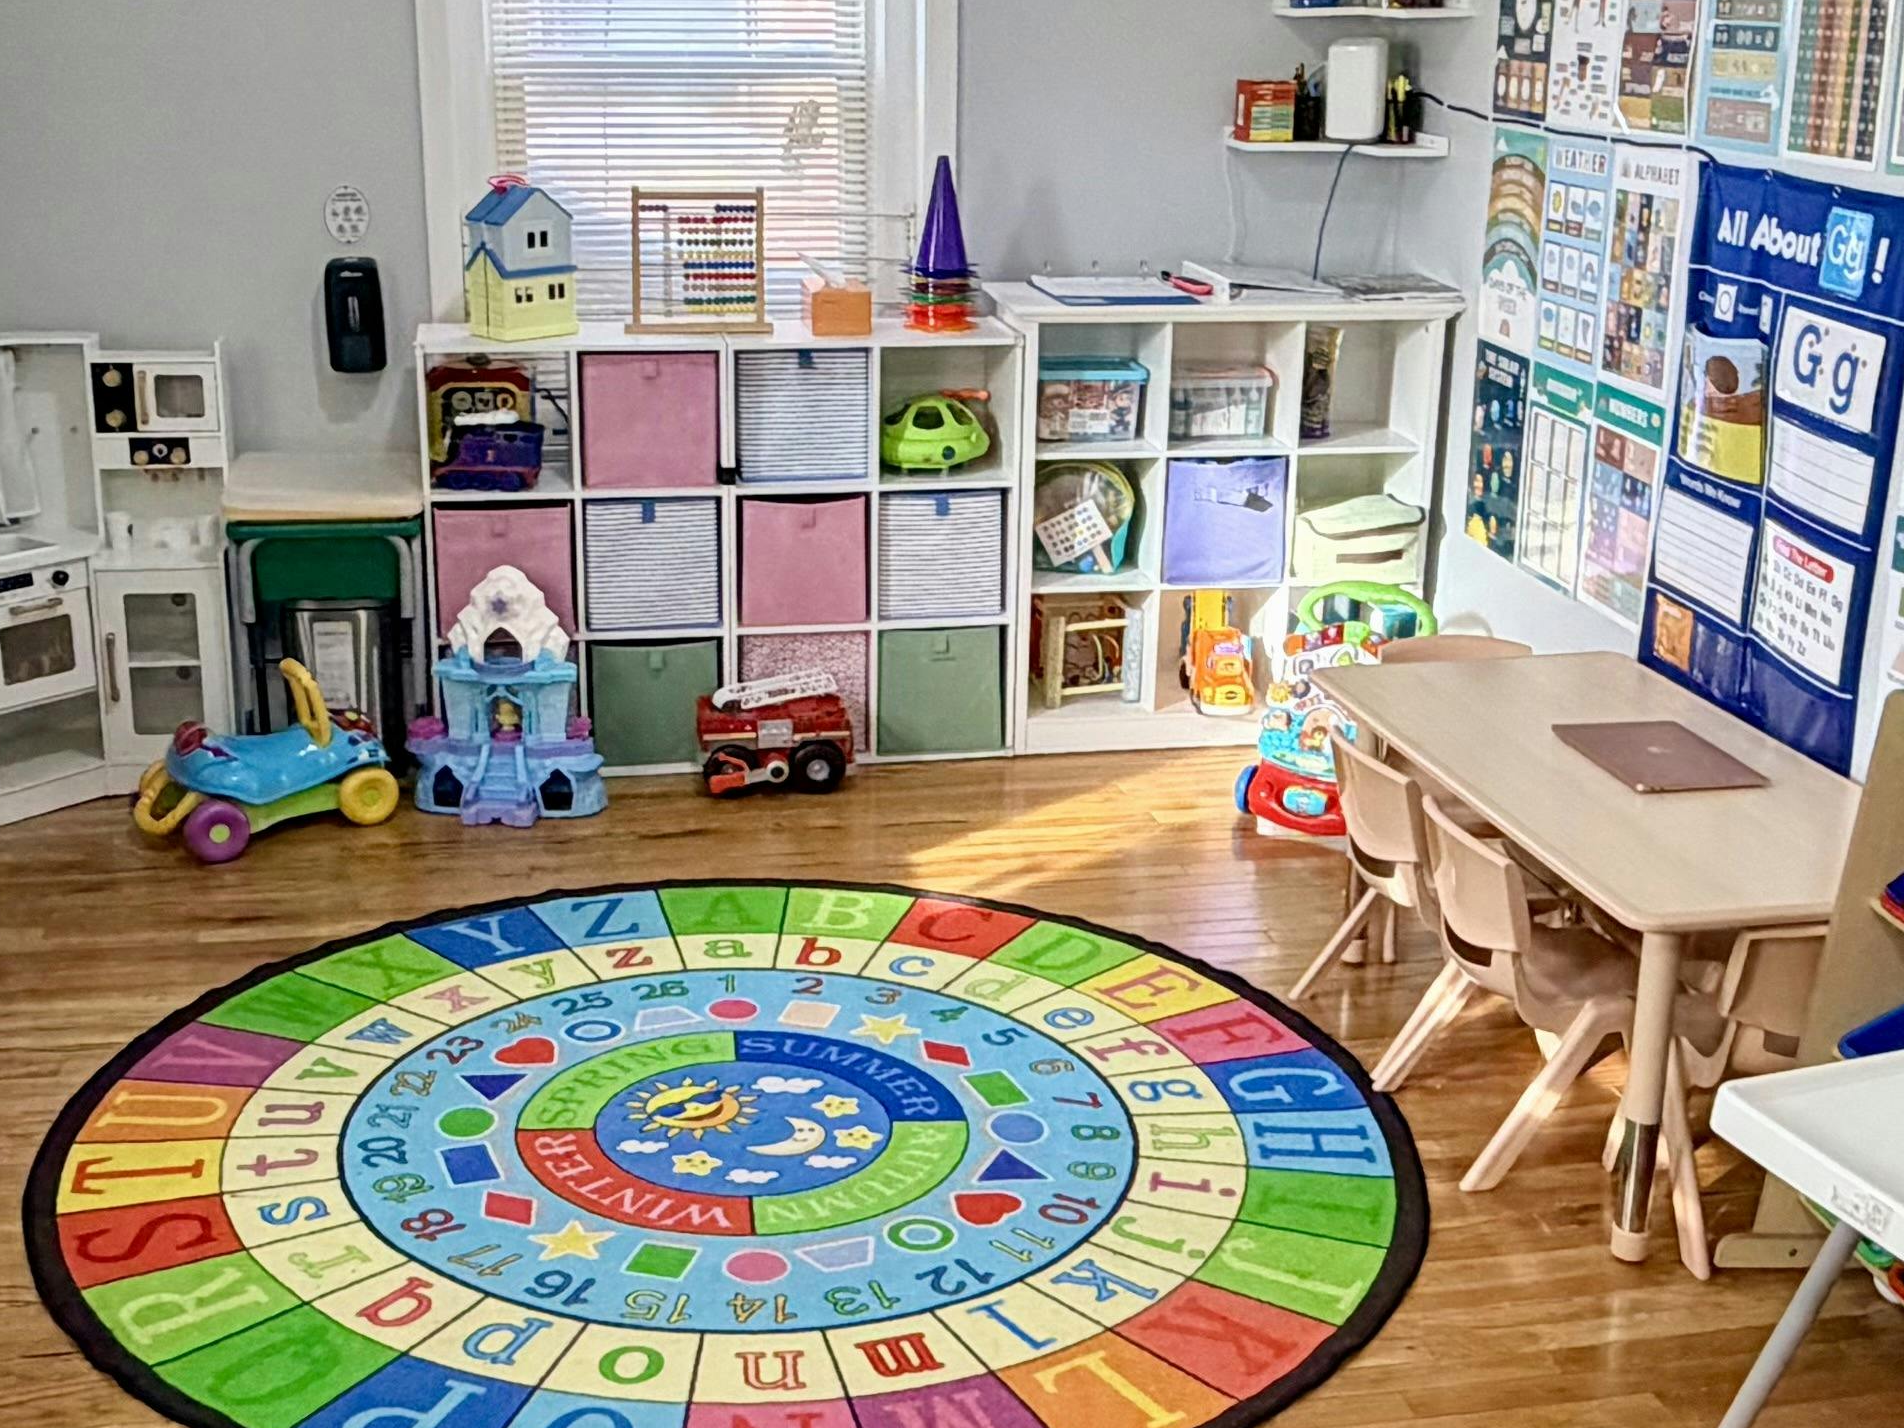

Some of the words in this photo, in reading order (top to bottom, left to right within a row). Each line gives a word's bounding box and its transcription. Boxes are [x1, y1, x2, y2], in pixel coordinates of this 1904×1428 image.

[1556, 149, 1607, 174] WEATHER
[1634, 163, 1680, 186] ALPHABET
[1717, 206, 1748, 247] All
[1750, 214, 1822, 266] About
[1828, 224, 1864, 279] Gg
[571, 897, 641, 941] Z
[702, 892, 755, 927] A
[803, 892, 873, 930] B
[919, 908, 994, 942] C
[442, 912, 524, 955] Y
[703, 939, 753, 959] a
[606, 946, 653, 970] z
[796, 936, 843, 965] b
[889, 956, 935, 976] c
[1015, 933, 1101, 970] D
[508, 958, 555, 989] y
[631, 979, 690, 1000] 26
[717, 974, 736, 992] 1
[792, 977, 823, 995] 2
[965, 974, 1030, 1001] d
[1095, 965, 1202, 1011] E
[423, 984, 491, 1013] x
[553, 992, 613, 1016] 25
[865, 986, 903, 1005] 3
[489, 1011, 542, 1035] 24
[930, 1006, 969, 1022] 4
[1044, 1007, 1095, 1029] e
[1165, 1012, 1286, 1046] F
[345, 1017, 414, 1045] w
[982, 1027, 1029, 1047] 5
[151, 1035, 272, 1069] V
[426, 1035, 484, 1064] 23
[1085, 1037, 1170, 1062] f
[295, 1056, 359, 1080] v
[535, 1038, 713, 1128] SPRING
[740, 1035, 941, 1117] SUMMER
[1029, 1059, 1074, 1074] 6
[390, 1069, 438, 1098] 22
[1128, 1079, 1204, 1102] g
[1229, 1067, 1343, 1103] G
[95, 1092, 228, 1128] U
[257, 1101, 325, 1127] u
[368, 1103, 419, 1128] 21
[1052, 1092, 1103, 1110] 7
[1071, 1124, 1120, 1142] 8
[1149, 1123, 1236, 1151] h
[1254, 1122, 1377, 1163] H
[237, 1147, 320, 1177] t
[357, 1135, 408, 1168] 20
[71, 1156, 205, 1195] T
[535, 1132, 731, 1228] WINTER
[766, 1124, 946, 1227] AUTUMN
[1067, 1162, 1117, 1181] 9
[1150, 1172, 1237, 1197] i
[372, 1173, 434, 1204] 19
[257, 1195, 330, 1225] s
[1039, 1192, 1101, 1224] 10
[74, 1213, 218, 1263] S
[401, 1208, 467, 1242] 18
[1111, 1216, 1206, 1259] j
[287, 1244, 371, 1279] r
[447, 1243, 522, 1277] 17
[989, 1227, 1056, 1263] 11
[525, 1270, 596, 1307] 16
[915, 1257, 996, 1296] 12
[1051, 1259, 1159, 1302] k
[1222, 1236, 1362, 1311] J
[118, 1267, 270, 1346] R
[356, 1277, 434, 1327] q
[620, 1289, 691, 1324] 15
[728, 1292, 798, 1324] 14
[824, 1279, 900, 1316] 13
[462, 1317, 553, 1366] p
[967, 1300, 1058, 1350] l
[1140, 1295, 1298, 1377] K
[598, 1346, 665, 1385] o
[736, 1351, 807, 1391] n
[855, 1332, 944, 1377] m
